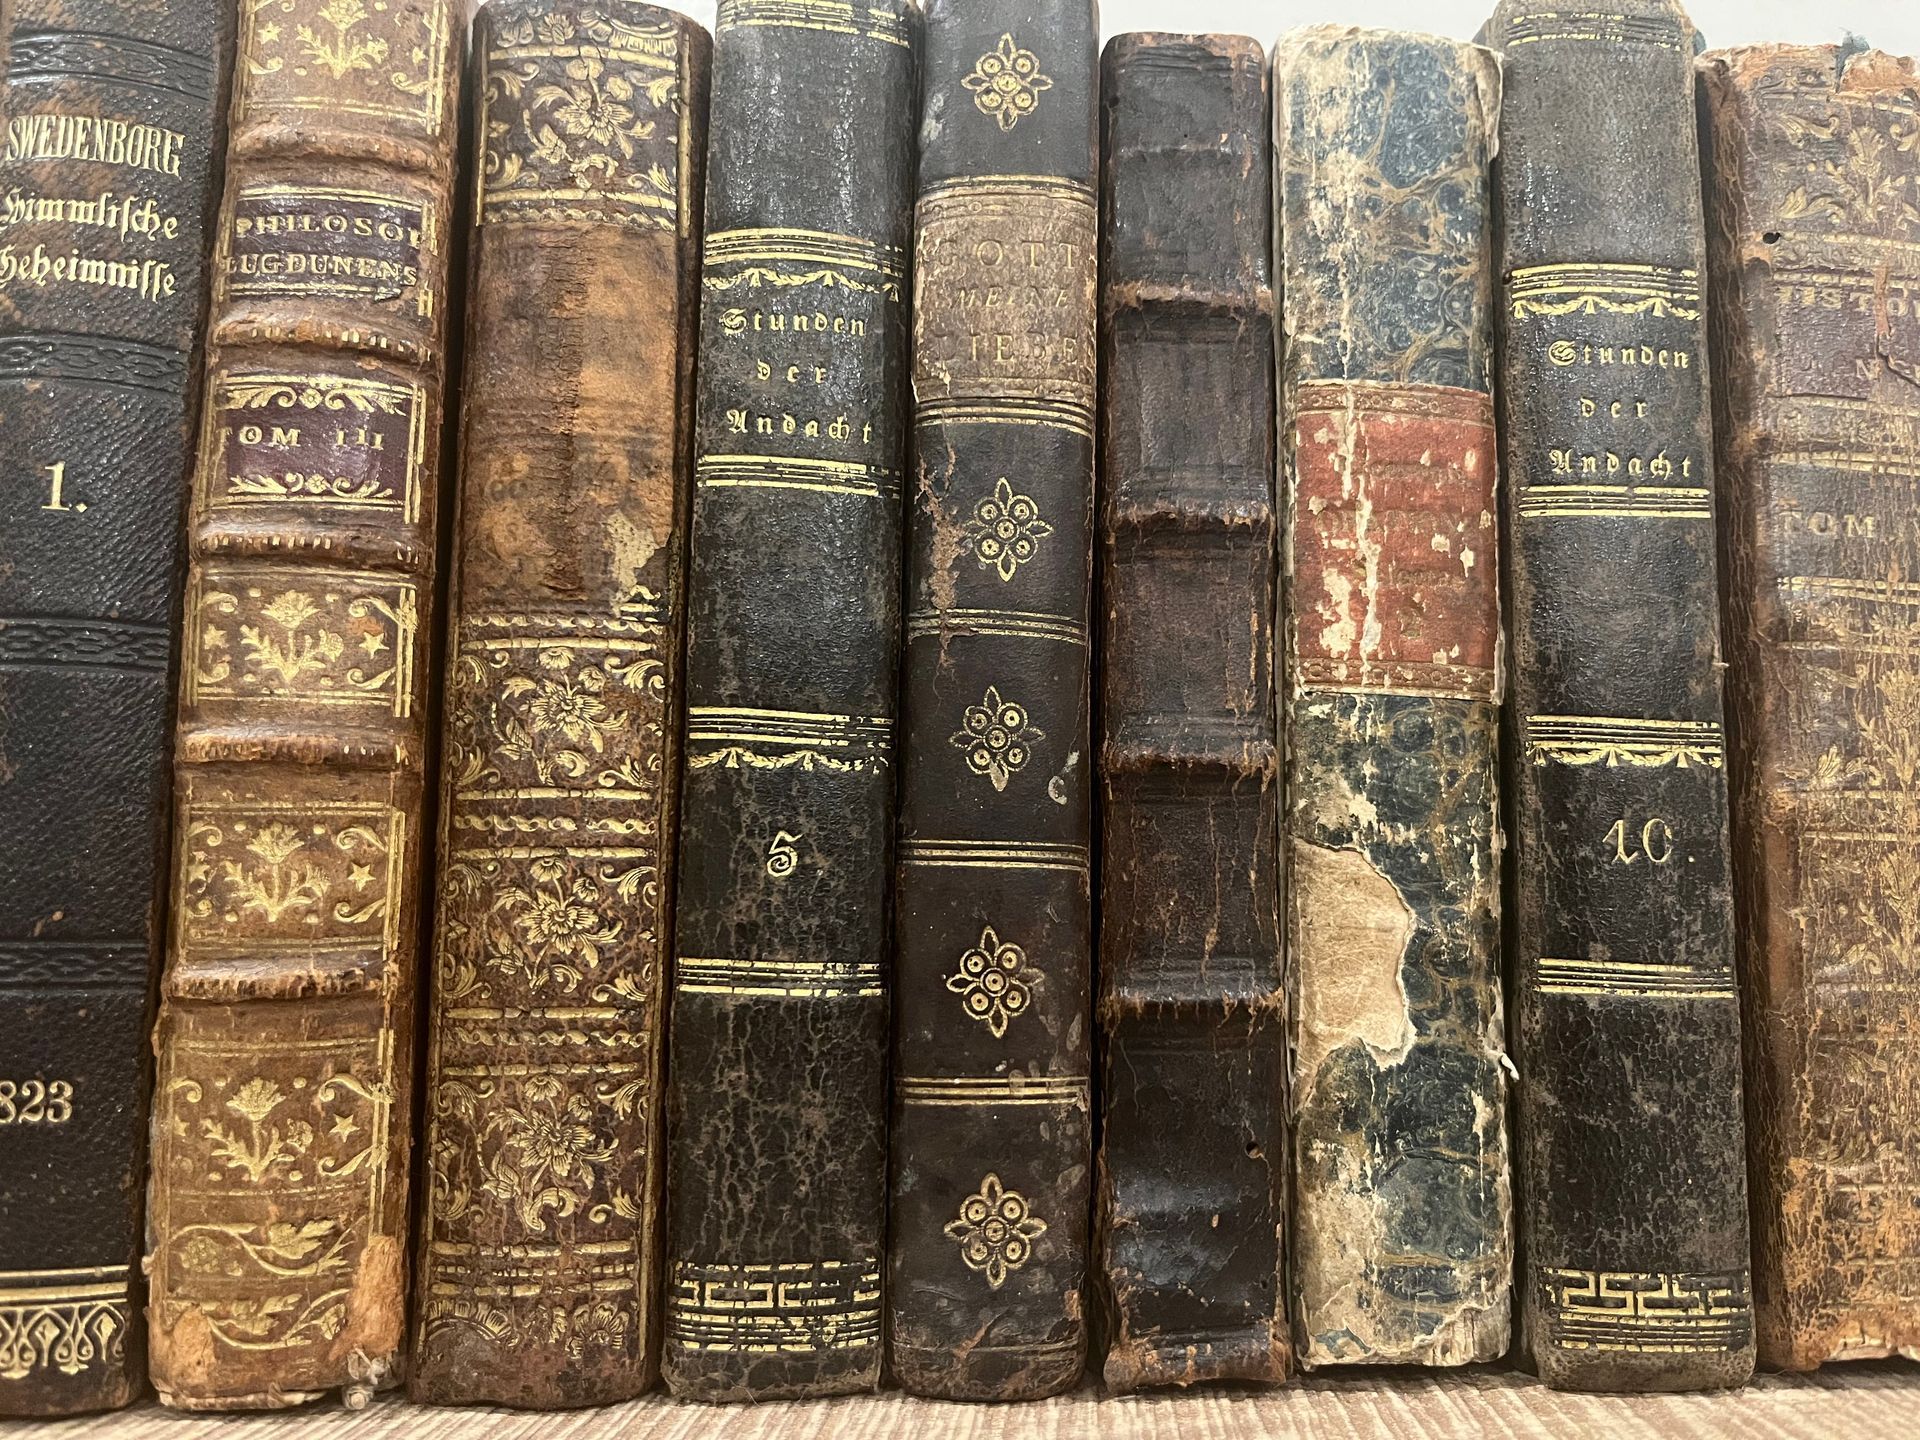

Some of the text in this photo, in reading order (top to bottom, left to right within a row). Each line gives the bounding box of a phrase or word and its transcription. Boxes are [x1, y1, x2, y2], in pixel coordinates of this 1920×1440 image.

[5, 114, 186, 178] SWEDENBORG
[718, 308, 867, 337] Stunden
[756, 358, 828, 384] der
[1548, 340, 1689, 368] Stunden
[1580, 397, 1648, 418] der
[726, 408, 872, 444] Andacht
[1549, 447, 1692, 481] Andacht
[41, 460, 88, 513] 1.
[766, 830, 803, 877] 5
